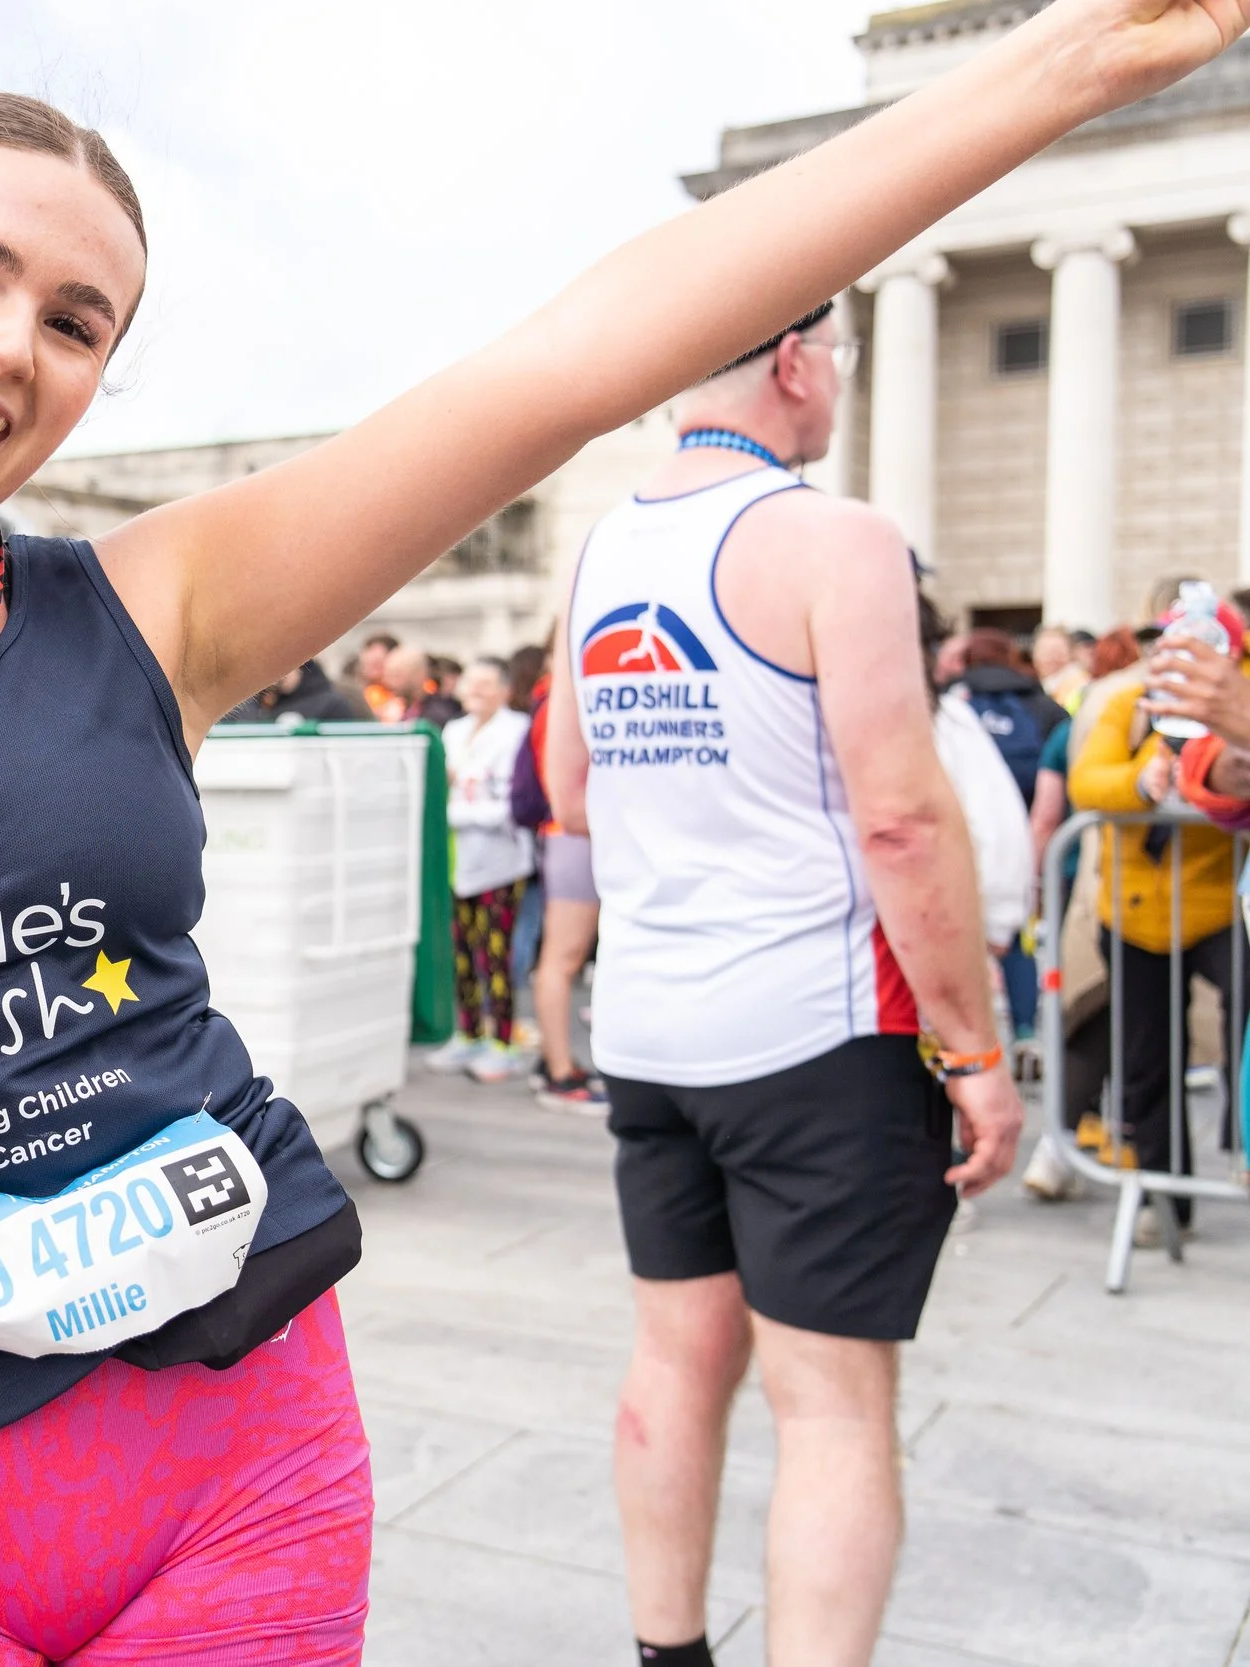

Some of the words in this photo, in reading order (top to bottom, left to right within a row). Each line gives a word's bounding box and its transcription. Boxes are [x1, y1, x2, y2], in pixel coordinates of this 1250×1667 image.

[626, 719, 725, 739] RUNNERS
[18, 1068, 132, 1119] Children
[78, 1136, 171, 1192] HAMPTON
[31, 1178, 174, 1280] 4720
[237, 1210, 251, 1220] 4720
[46, 1283, 147, 1342] Millie
